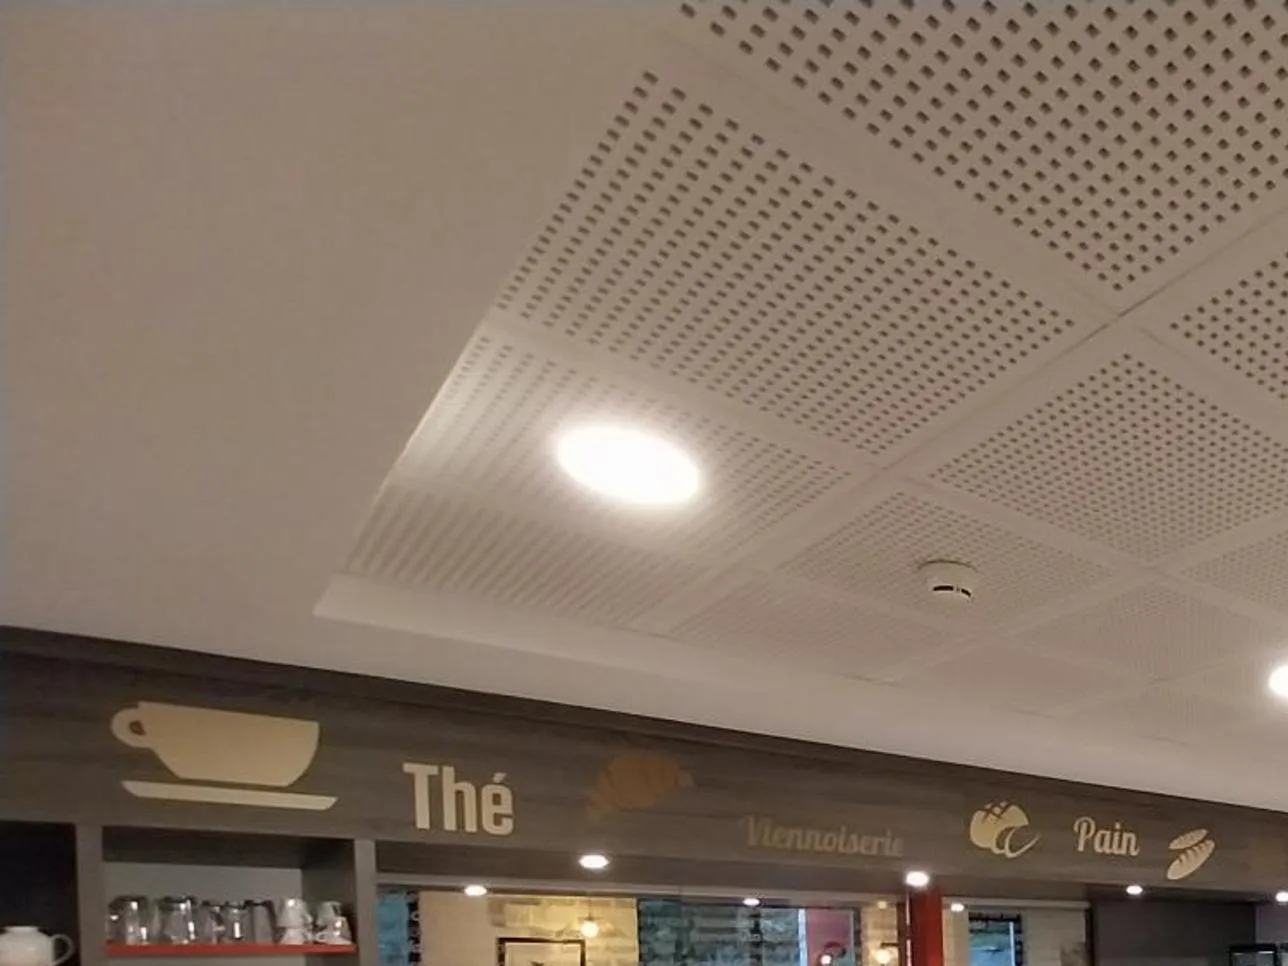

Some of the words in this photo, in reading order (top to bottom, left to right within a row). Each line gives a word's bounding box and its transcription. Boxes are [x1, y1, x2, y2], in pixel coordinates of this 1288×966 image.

[402, 762, 514, 835] Thé
[739, 814, 905, 858] Viennoiserie
[1073, 816, 1140, 856] Pain
